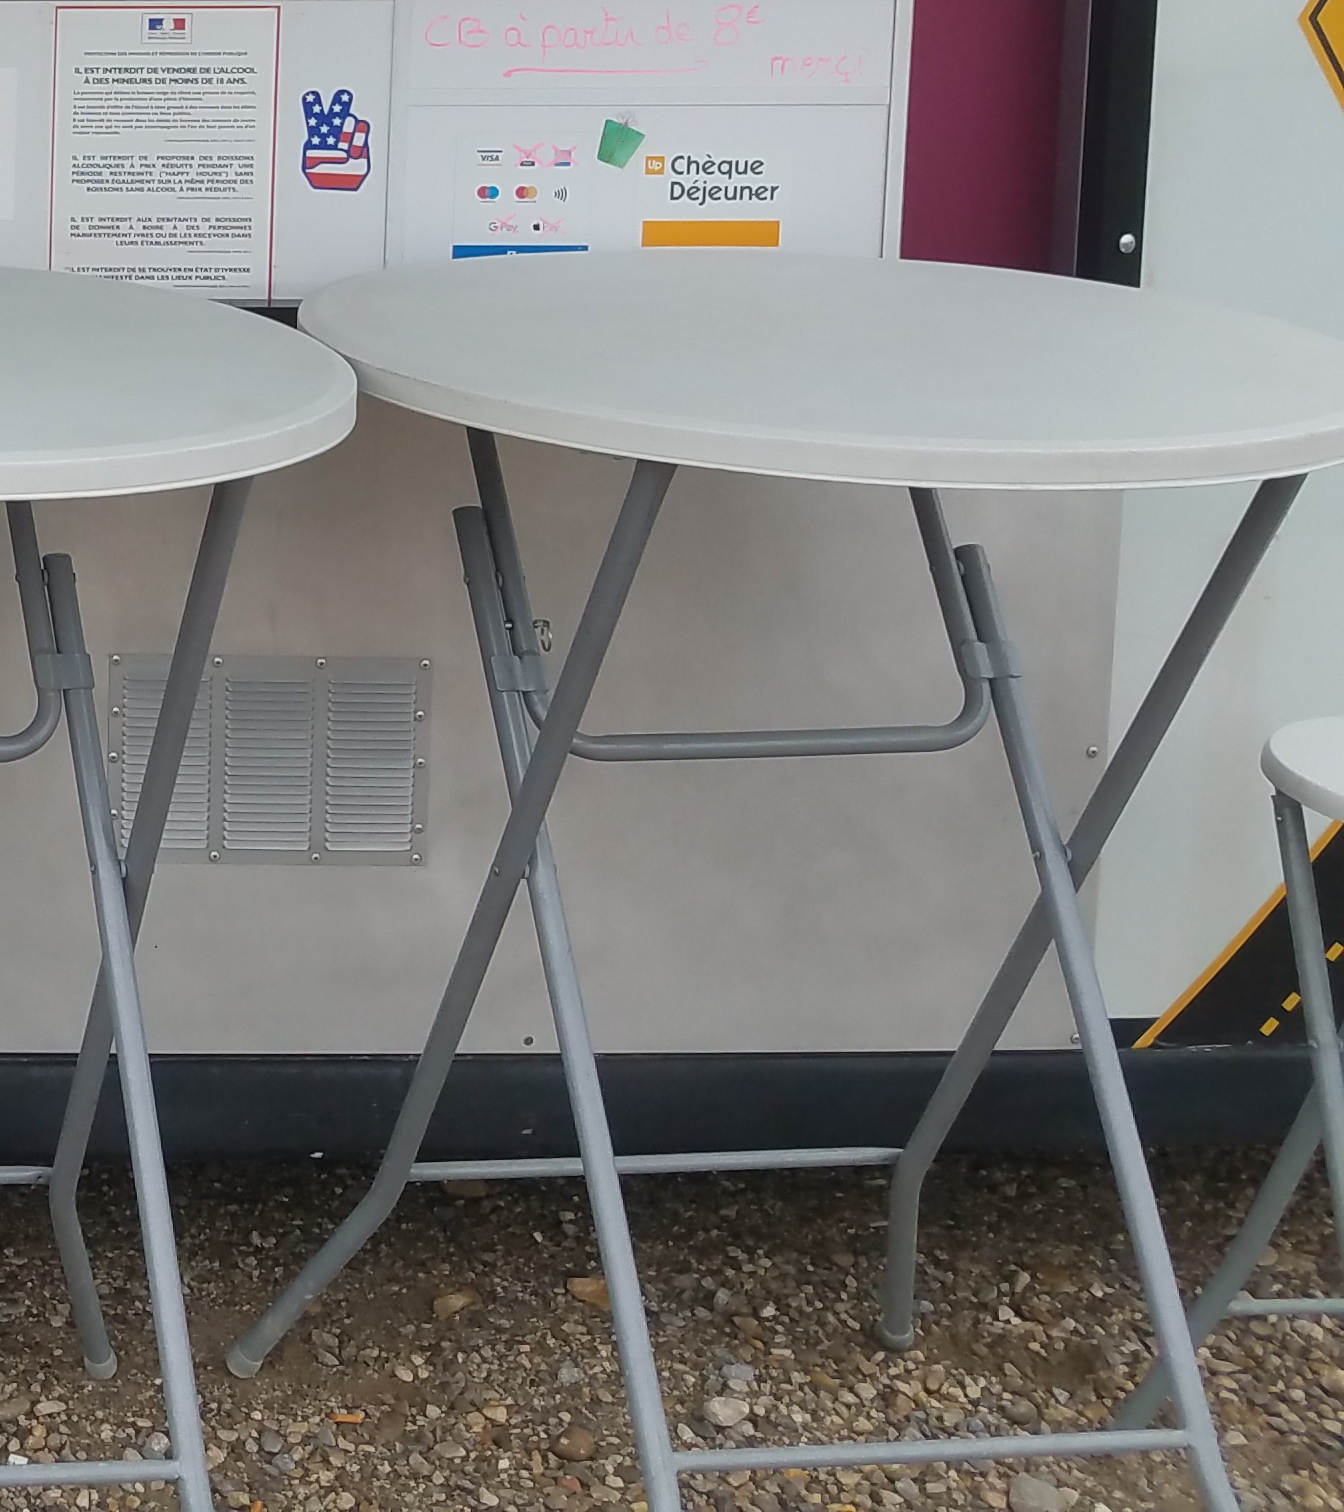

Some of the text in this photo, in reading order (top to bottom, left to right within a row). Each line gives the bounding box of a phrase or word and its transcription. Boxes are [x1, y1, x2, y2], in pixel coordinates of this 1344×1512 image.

[424, 14, 489, 48] CB
[504, 15, 531, 48] à
[655, 7, 695, 45] de
[74, 67, 257, 75] IL EST INTERDIT DE VENDRE DE L'ALCOOL
[84, 77, 247, 85] À DES MINEURS DE MOINS DE 18 ANS.
[671, 155, 764, 178] Chèque
[670, 182, 780, 205] Déjeuner
